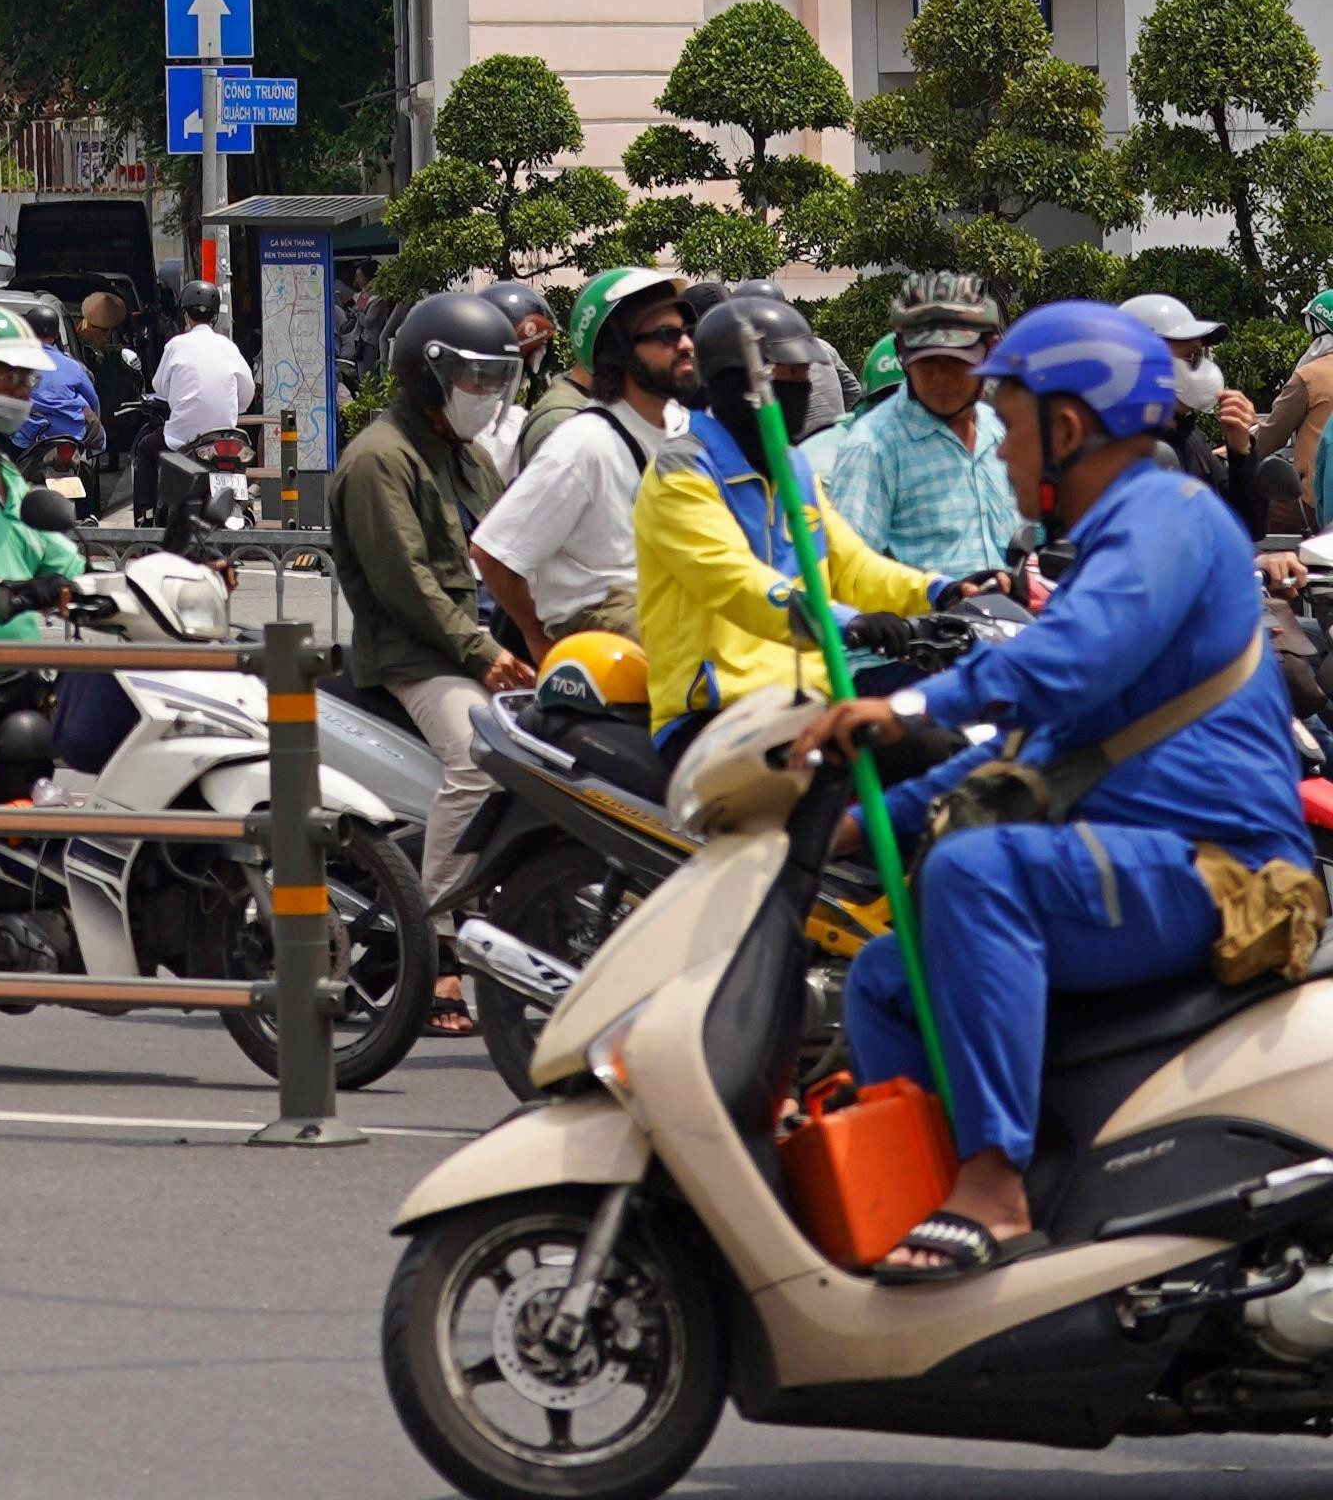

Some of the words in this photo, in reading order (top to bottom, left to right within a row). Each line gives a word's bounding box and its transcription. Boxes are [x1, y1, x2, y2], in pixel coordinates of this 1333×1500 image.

[224, 82, 251, 99] CÔNG
[255, 81, 295, 100] TRƯỜNG
[223, 102, 251, 120] QUÁCH
[268, 107, 295, 121] TRANG
[297, 251, 321, 259] STATION
[575, 305, 596, 348] Grab
[551, 675, 586, 700] TADA
